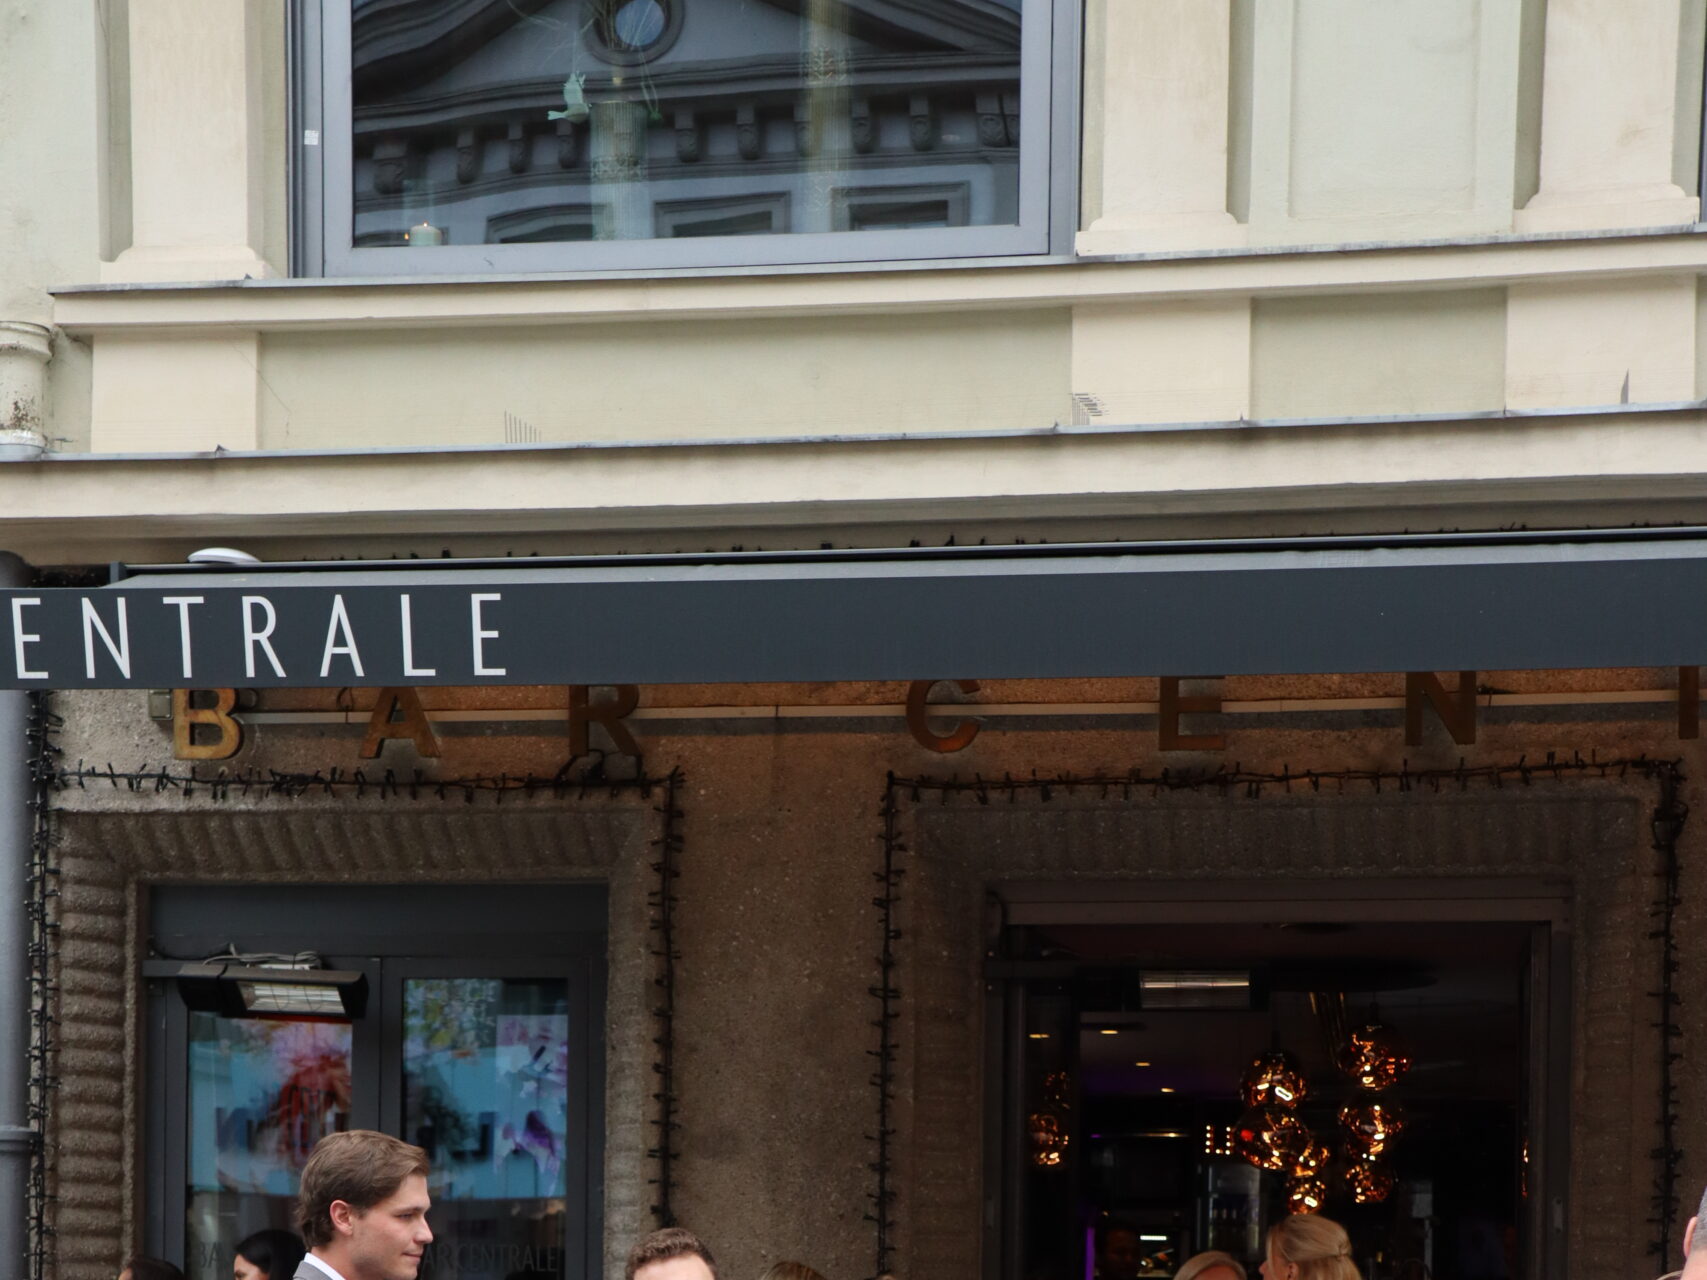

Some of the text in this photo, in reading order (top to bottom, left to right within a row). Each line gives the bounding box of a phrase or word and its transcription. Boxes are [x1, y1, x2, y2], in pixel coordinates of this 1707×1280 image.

[11, 593, 507, 679] ENTRALE
[173, 684, 641, 760] BAR
[456, 1243, 559, 1272] CENTRALE
